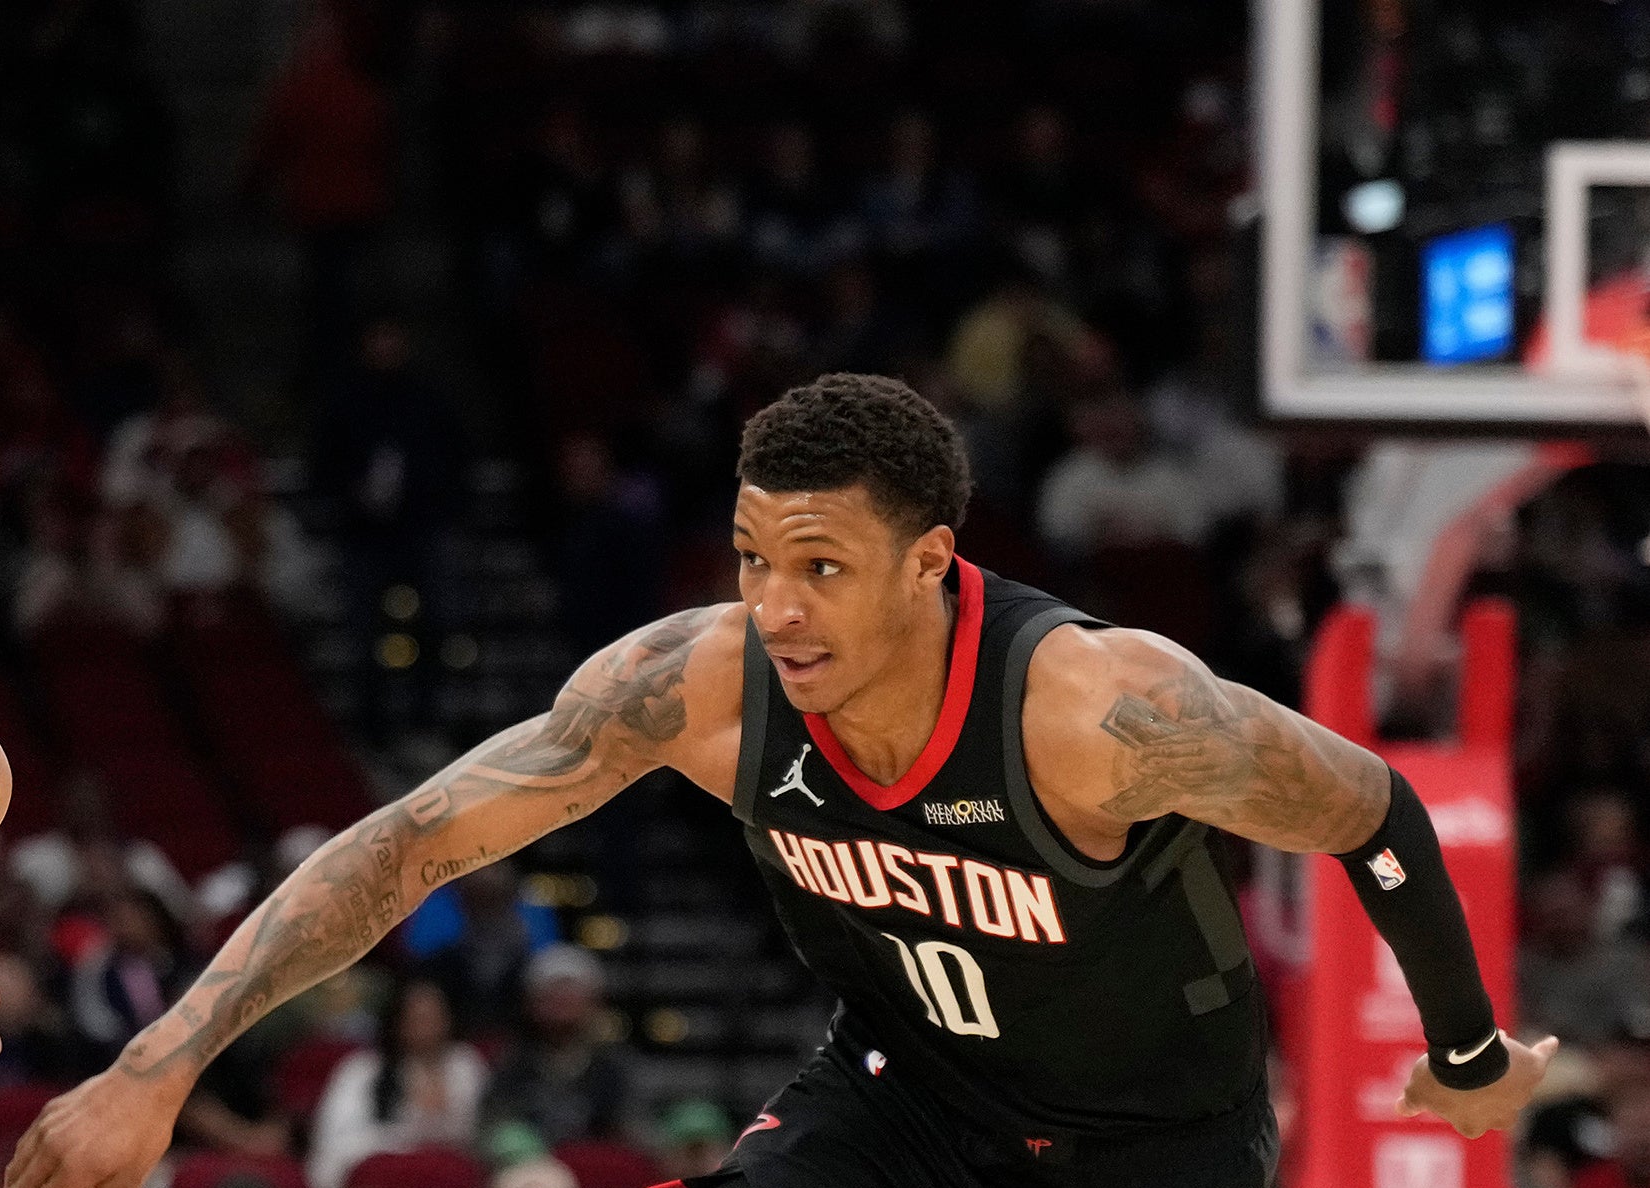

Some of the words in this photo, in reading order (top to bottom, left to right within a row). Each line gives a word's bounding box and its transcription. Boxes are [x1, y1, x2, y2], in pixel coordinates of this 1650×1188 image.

[924, 799, 1004, 816] MEMORIAL
[925, 810, 1005, 825] HERMANN
[769, 828, 1067, 943] HOUSTON
[881, 932, 1000, 1039] 10
